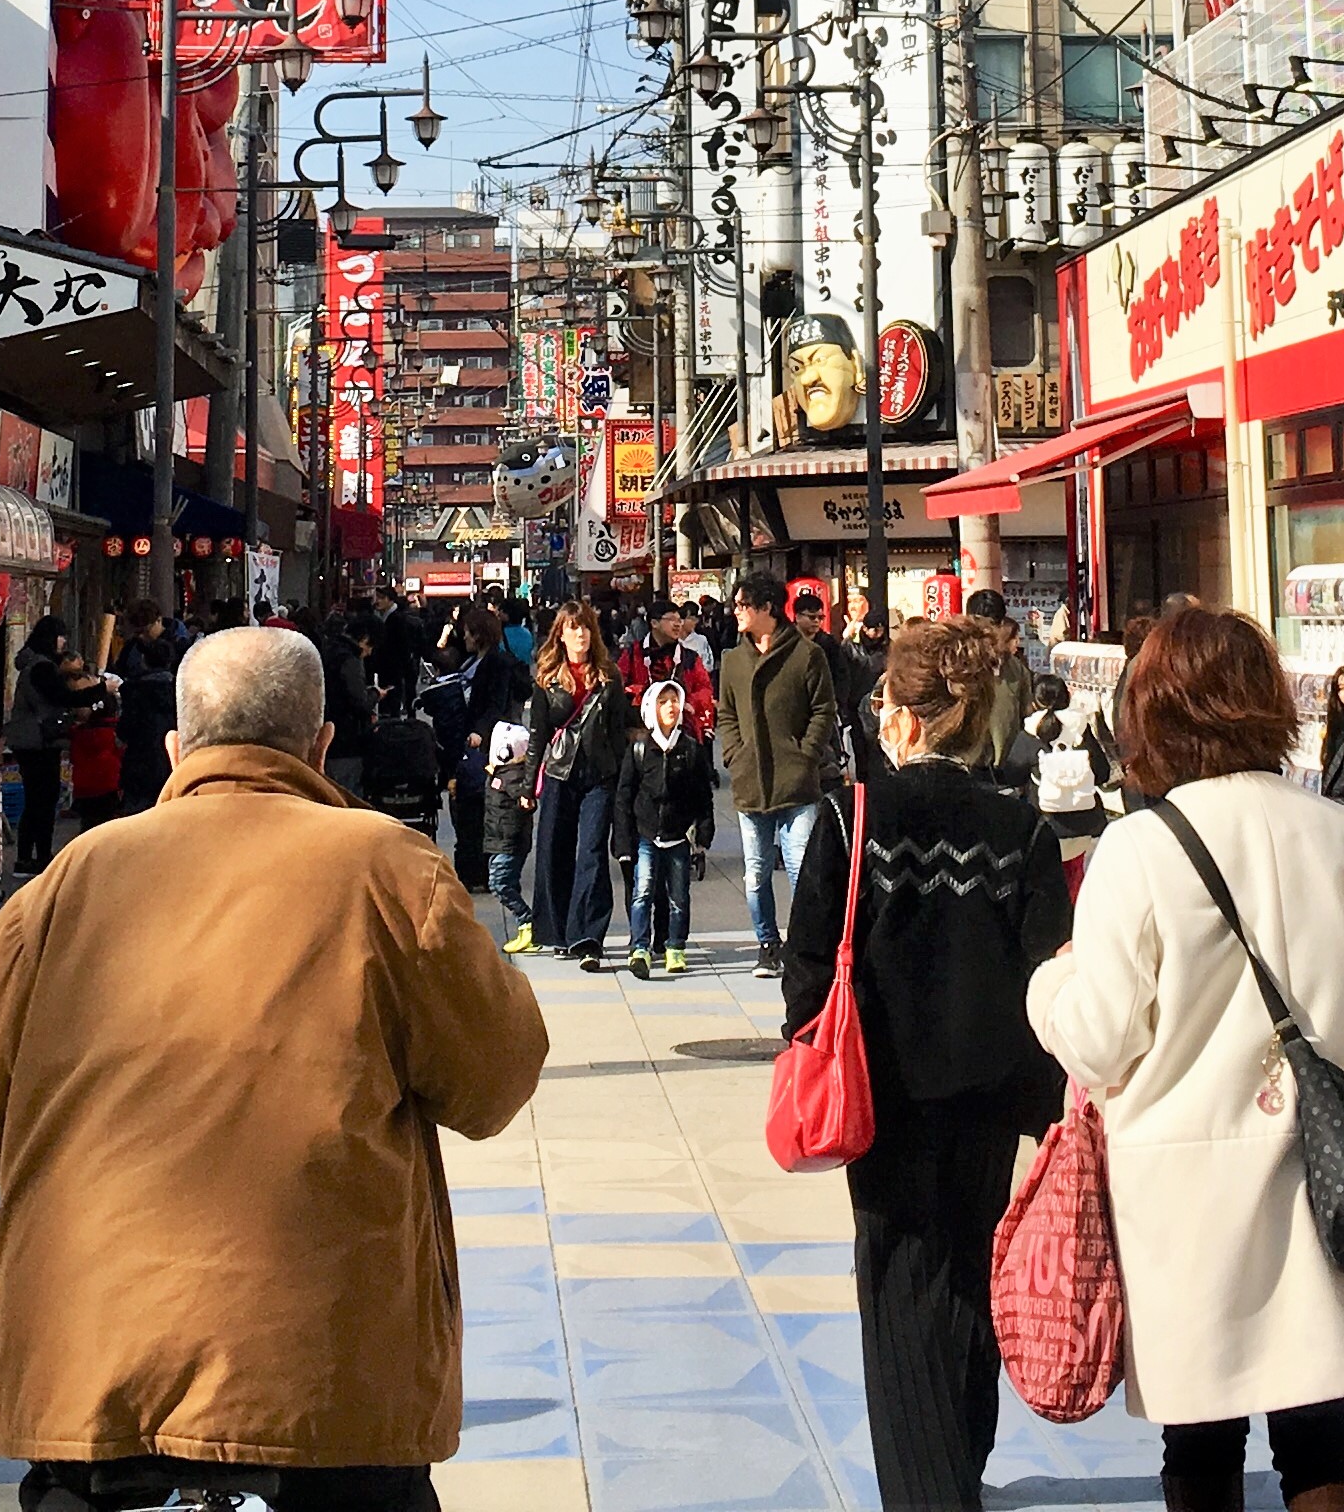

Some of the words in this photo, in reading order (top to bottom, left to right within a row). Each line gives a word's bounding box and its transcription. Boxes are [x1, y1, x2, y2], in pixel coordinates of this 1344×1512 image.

[1127, 194, 1222, 385] お好み焼き
